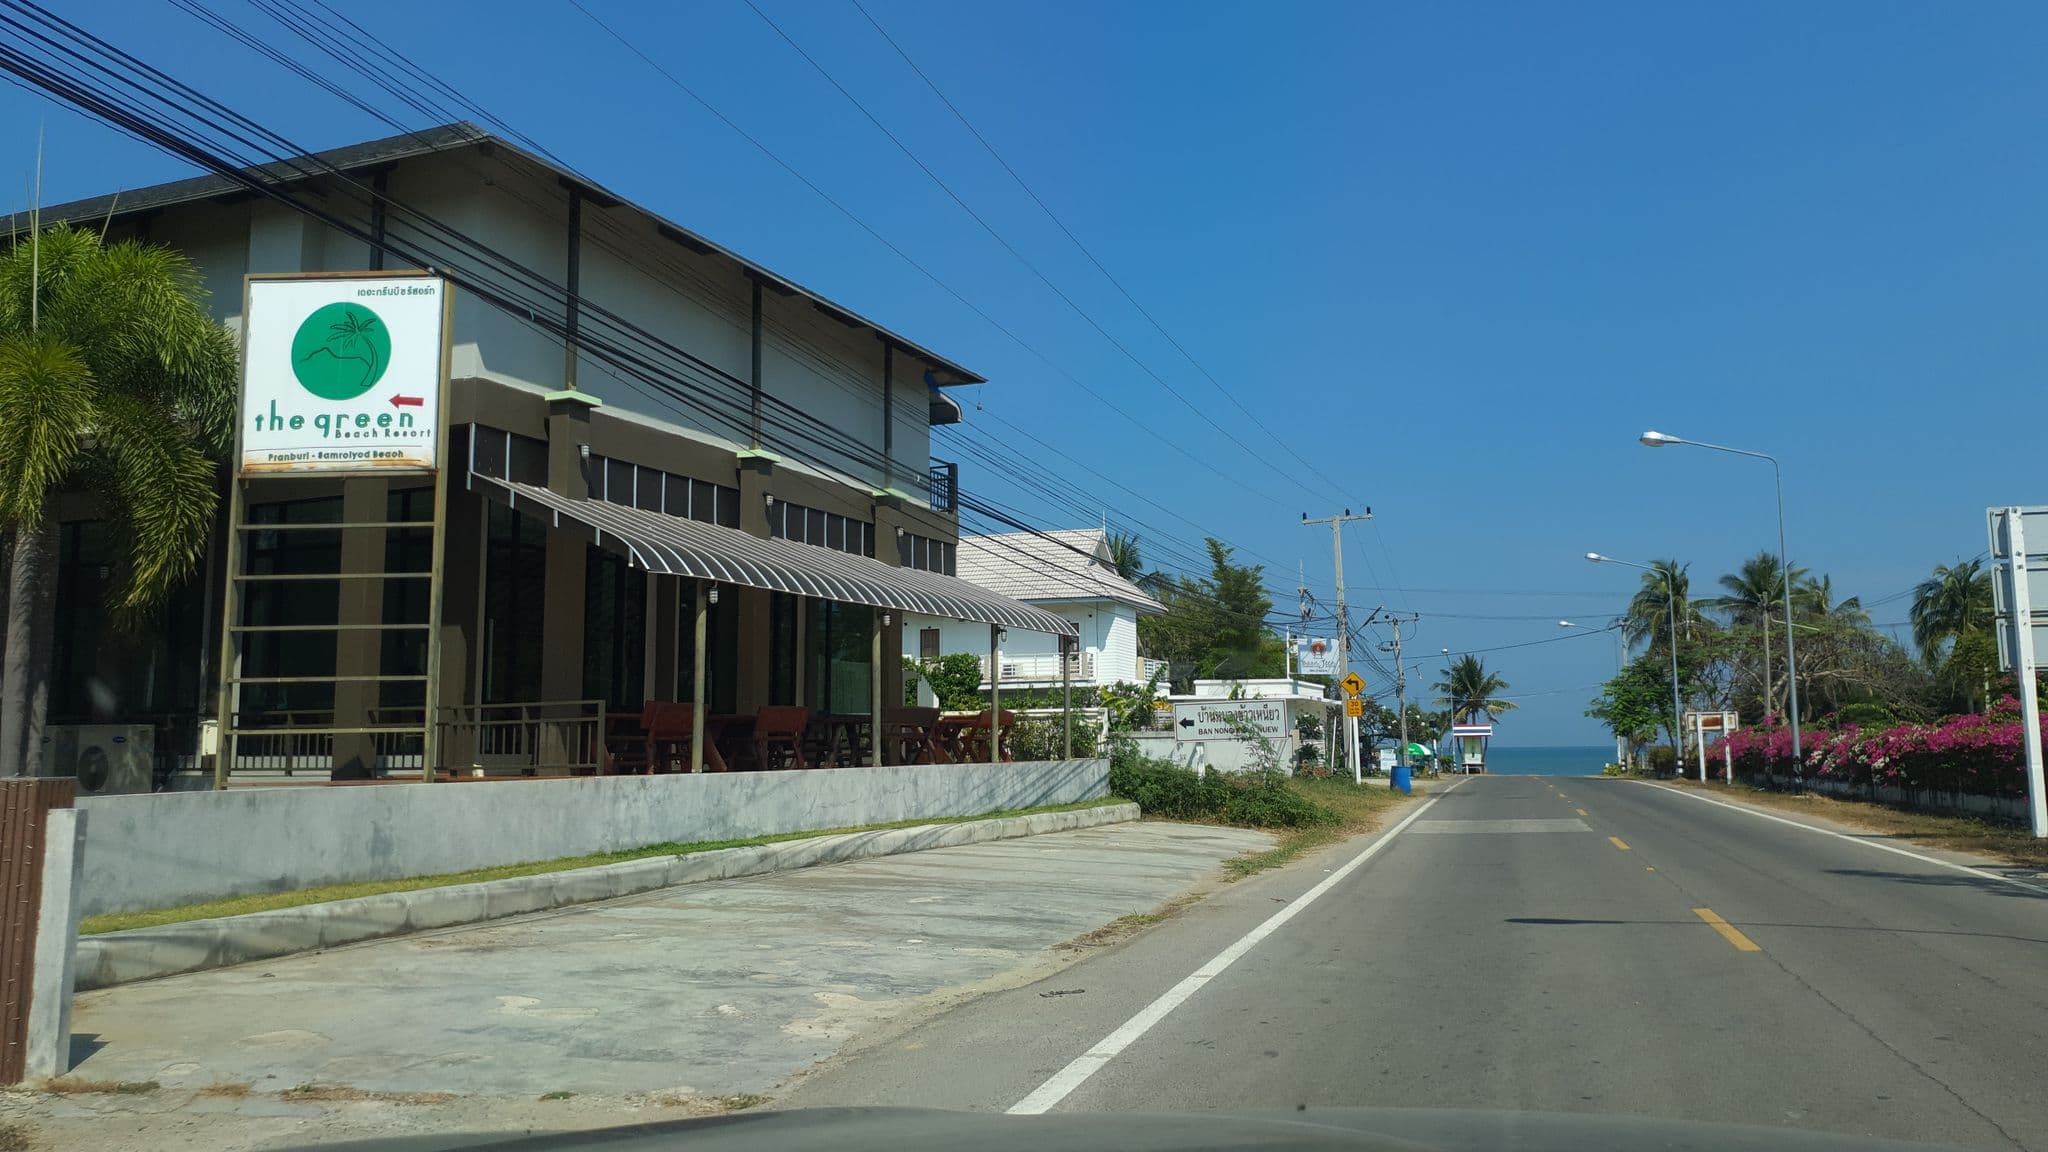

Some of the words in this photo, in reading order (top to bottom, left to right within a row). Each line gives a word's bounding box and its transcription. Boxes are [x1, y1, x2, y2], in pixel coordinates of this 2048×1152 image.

[255, 399, 305, 432] the
[314, 411, 414, 438] green
[335, 428, 378, 438] Beach
[385, 428, 432, 438] Resort
[268, 451, 309, 461] Pranburi
[373, 449, 404, 458] Beach
[1199, 728, 1213, 736] BAN
[1214, 726, 1235, 735] NONG
